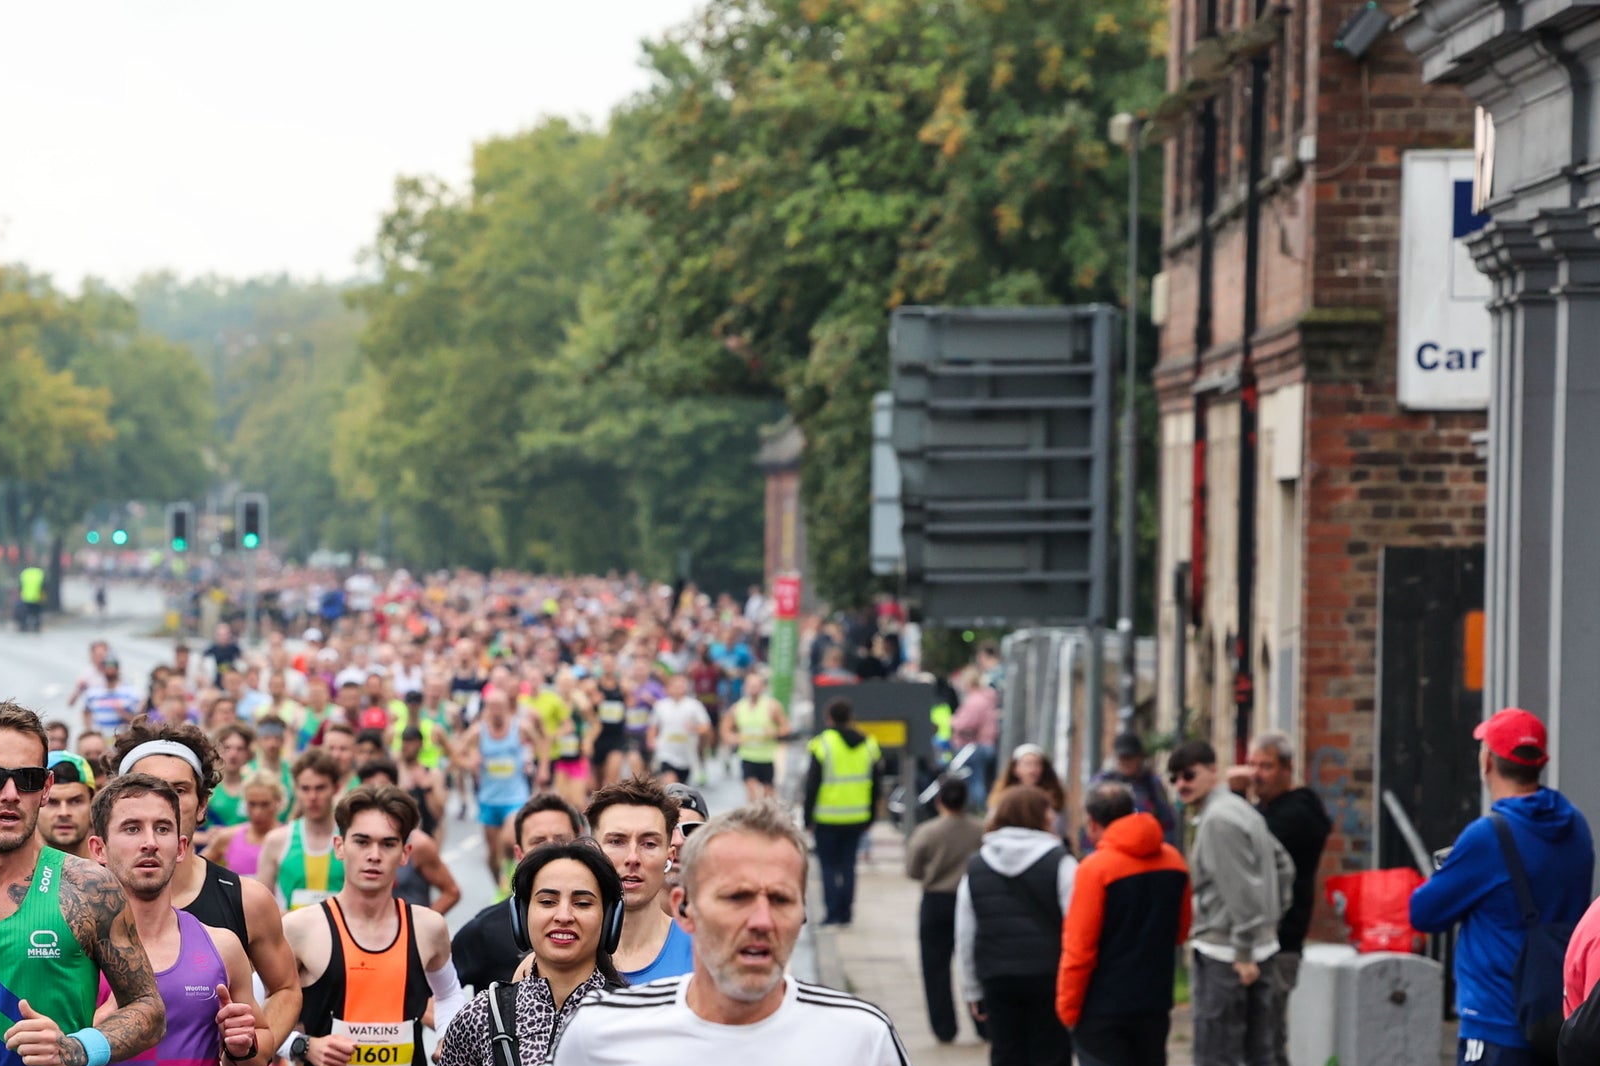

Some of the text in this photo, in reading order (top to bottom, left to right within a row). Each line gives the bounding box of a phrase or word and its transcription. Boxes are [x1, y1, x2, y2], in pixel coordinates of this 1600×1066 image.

[1416, 342, 1486, 370] Car
[39, 865, 53, 893] soar
[28, 948, 61, 956] MH&AC
[349, 1026, 399, 1035] WATKINS
[356, 1047, 398, 1063] 1601
